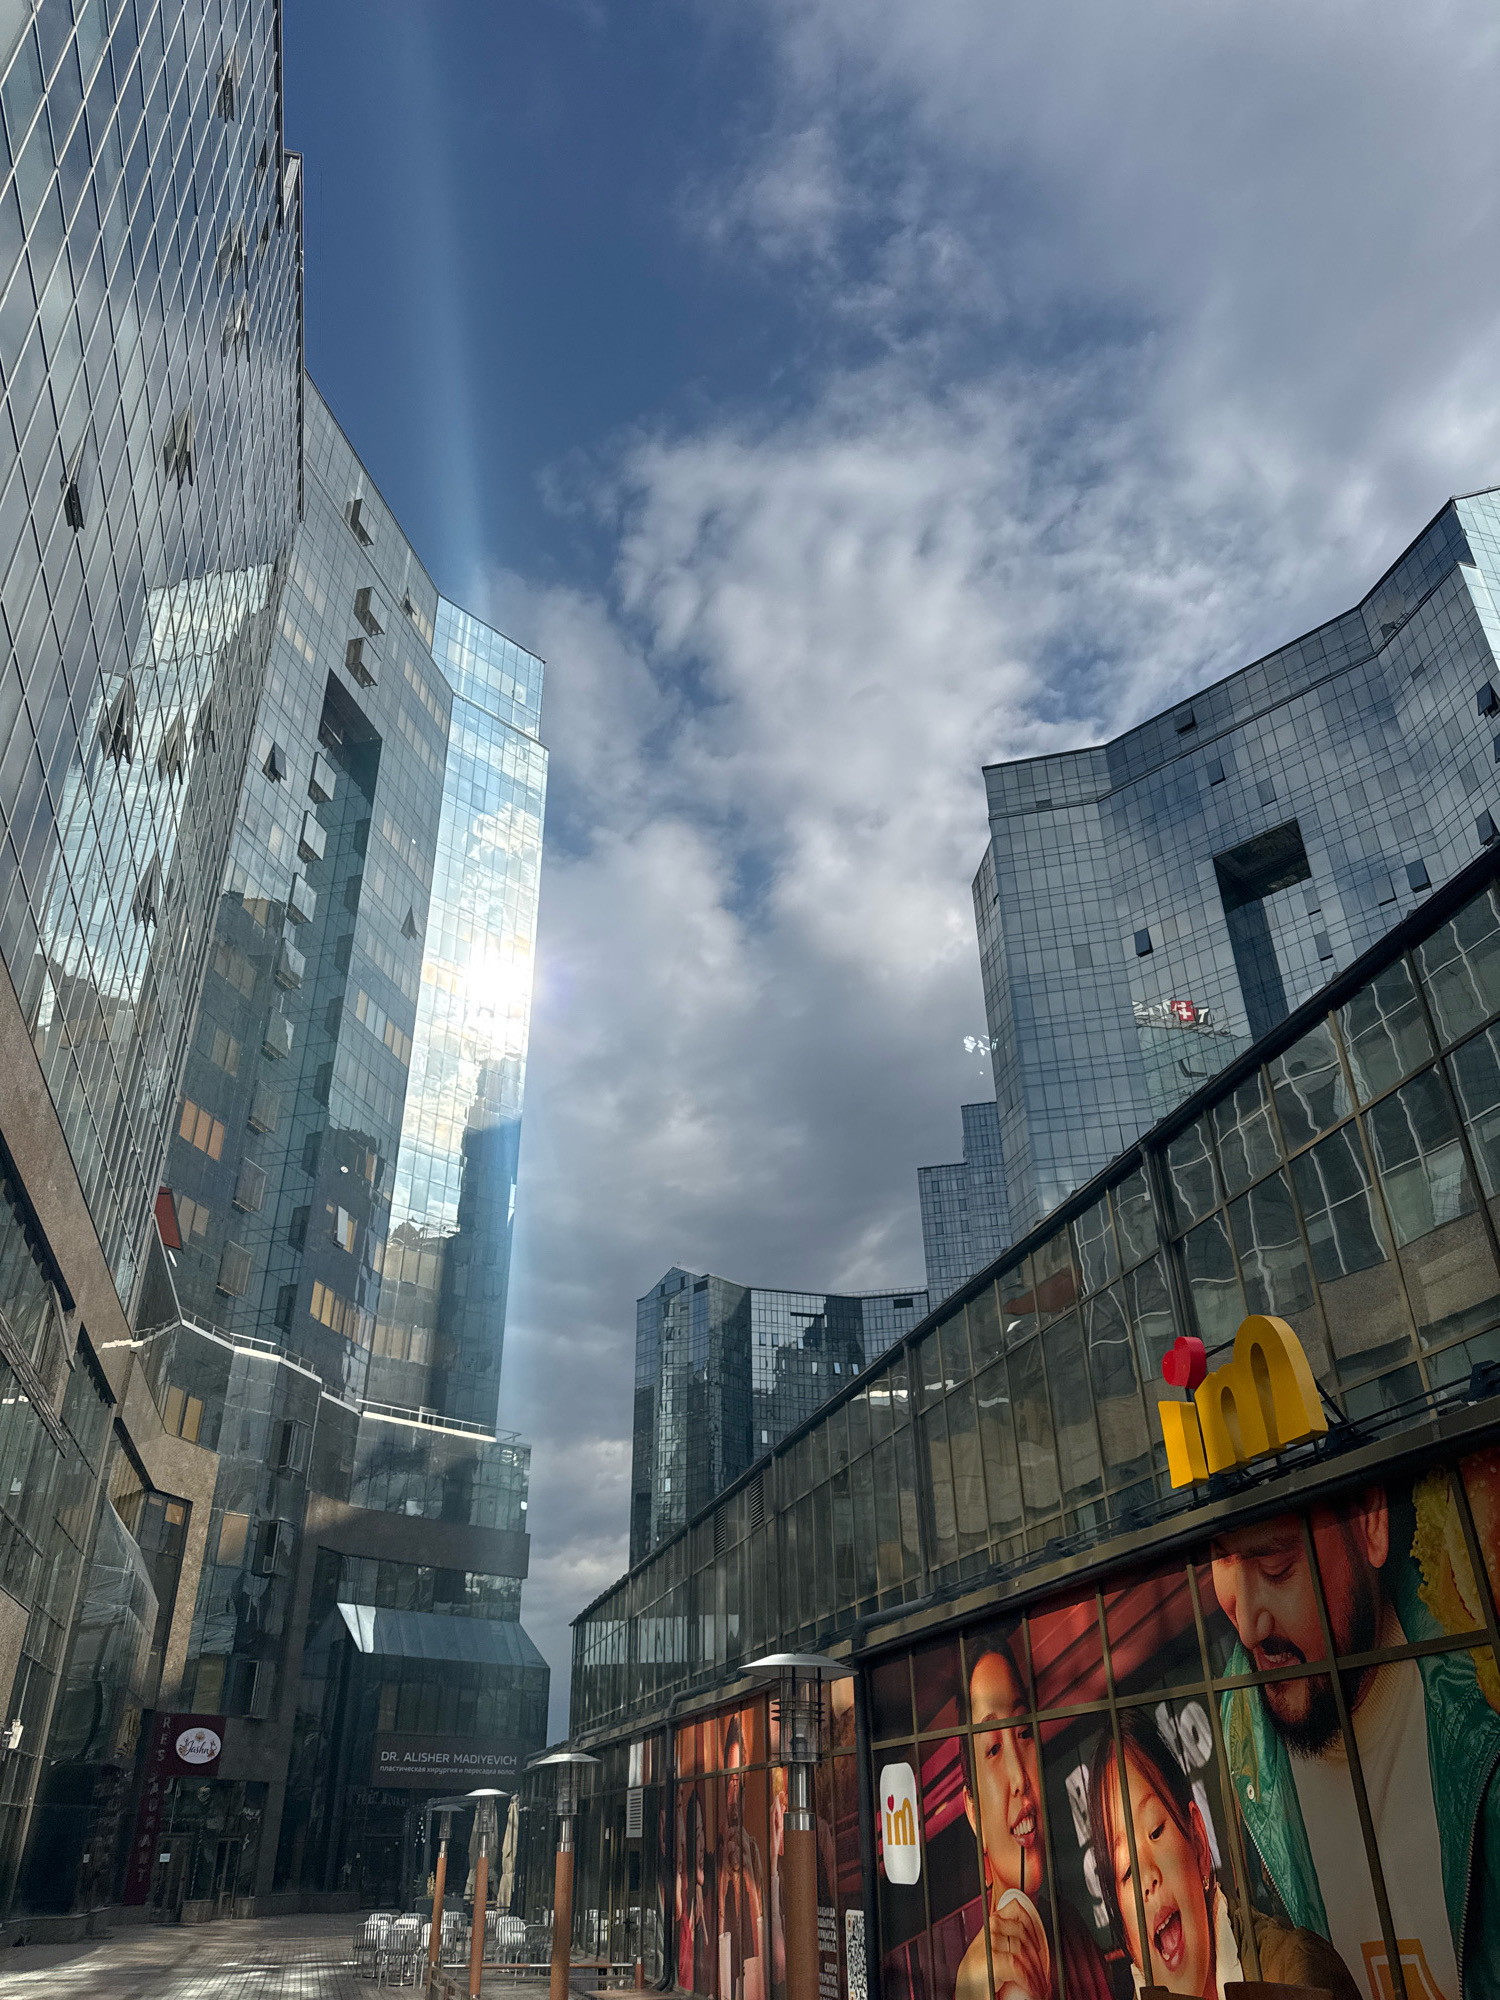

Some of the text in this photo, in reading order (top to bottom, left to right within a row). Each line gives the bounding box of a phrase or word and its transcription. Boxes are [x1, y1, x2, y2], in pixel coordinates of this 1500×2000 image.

[186, 1740, 209, 1756] Jashn
[381, 1751, 517, 1766] DR. ALISHER MADIYEVICH
[427, 1767, 457, 1775] хирургия
[464, 1768, 497, 1776] пересадка
[138, 1717, 171, 1883] RESAURANT
